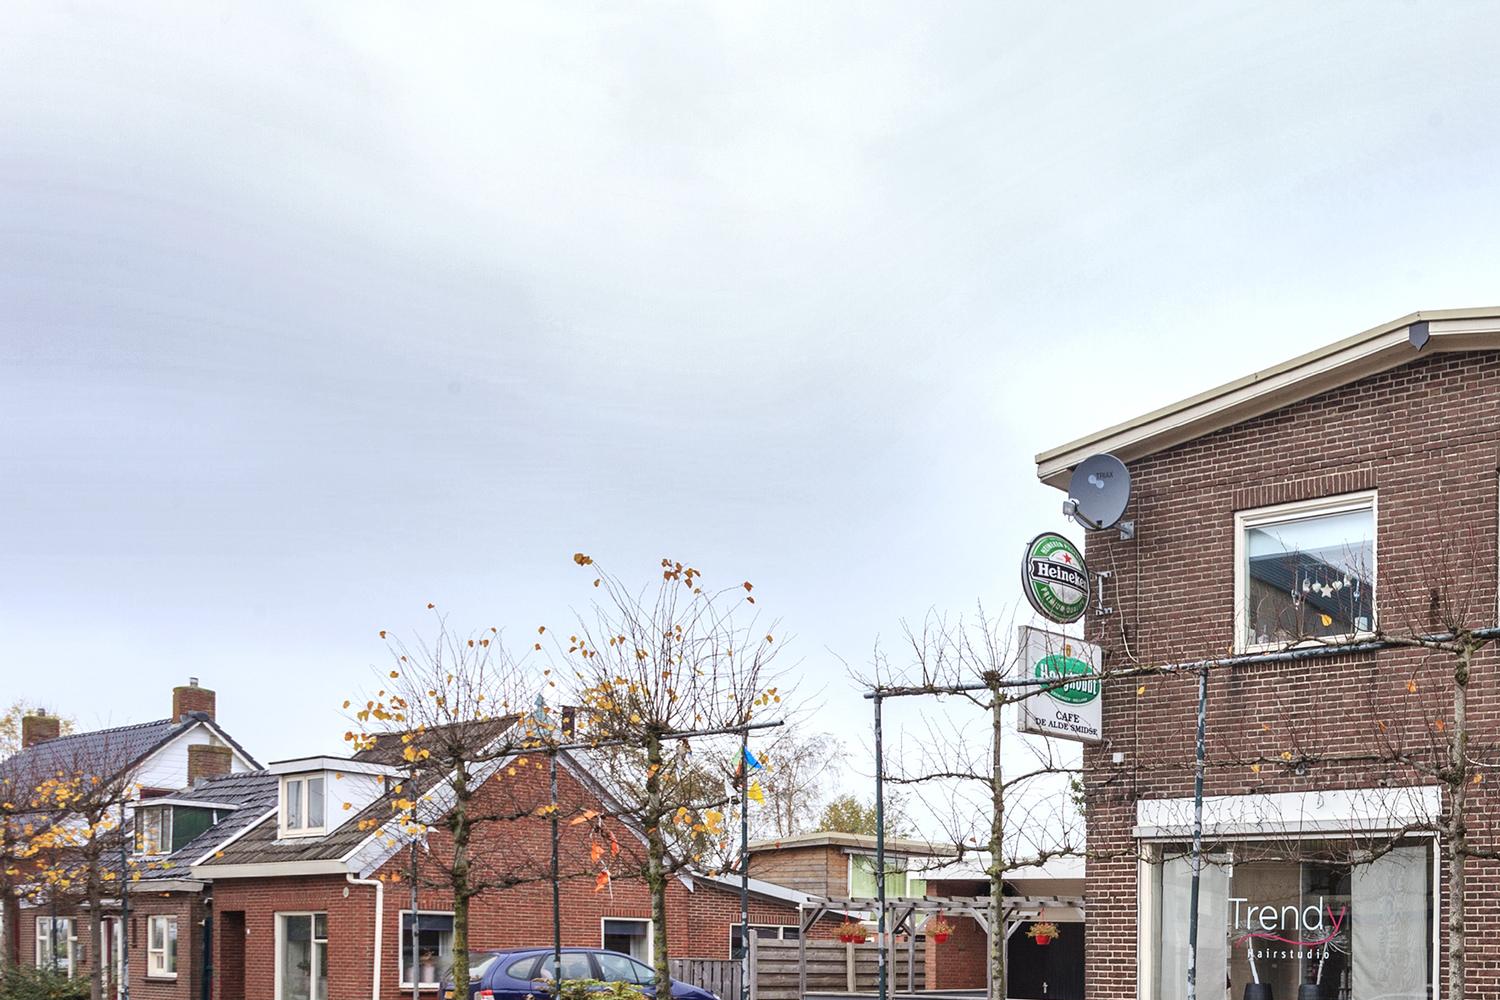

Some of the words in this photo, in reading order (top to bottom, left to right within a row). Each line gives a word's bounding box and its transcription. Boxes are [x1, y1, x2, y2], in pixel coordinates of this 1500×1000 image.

[1055, 710, 1080, 723] CAFE
[1035, 717, 1047, 726] DE
[1048, 720, 1069, 730] ALDE
[1228, 896, 1346, 944] Trendy
